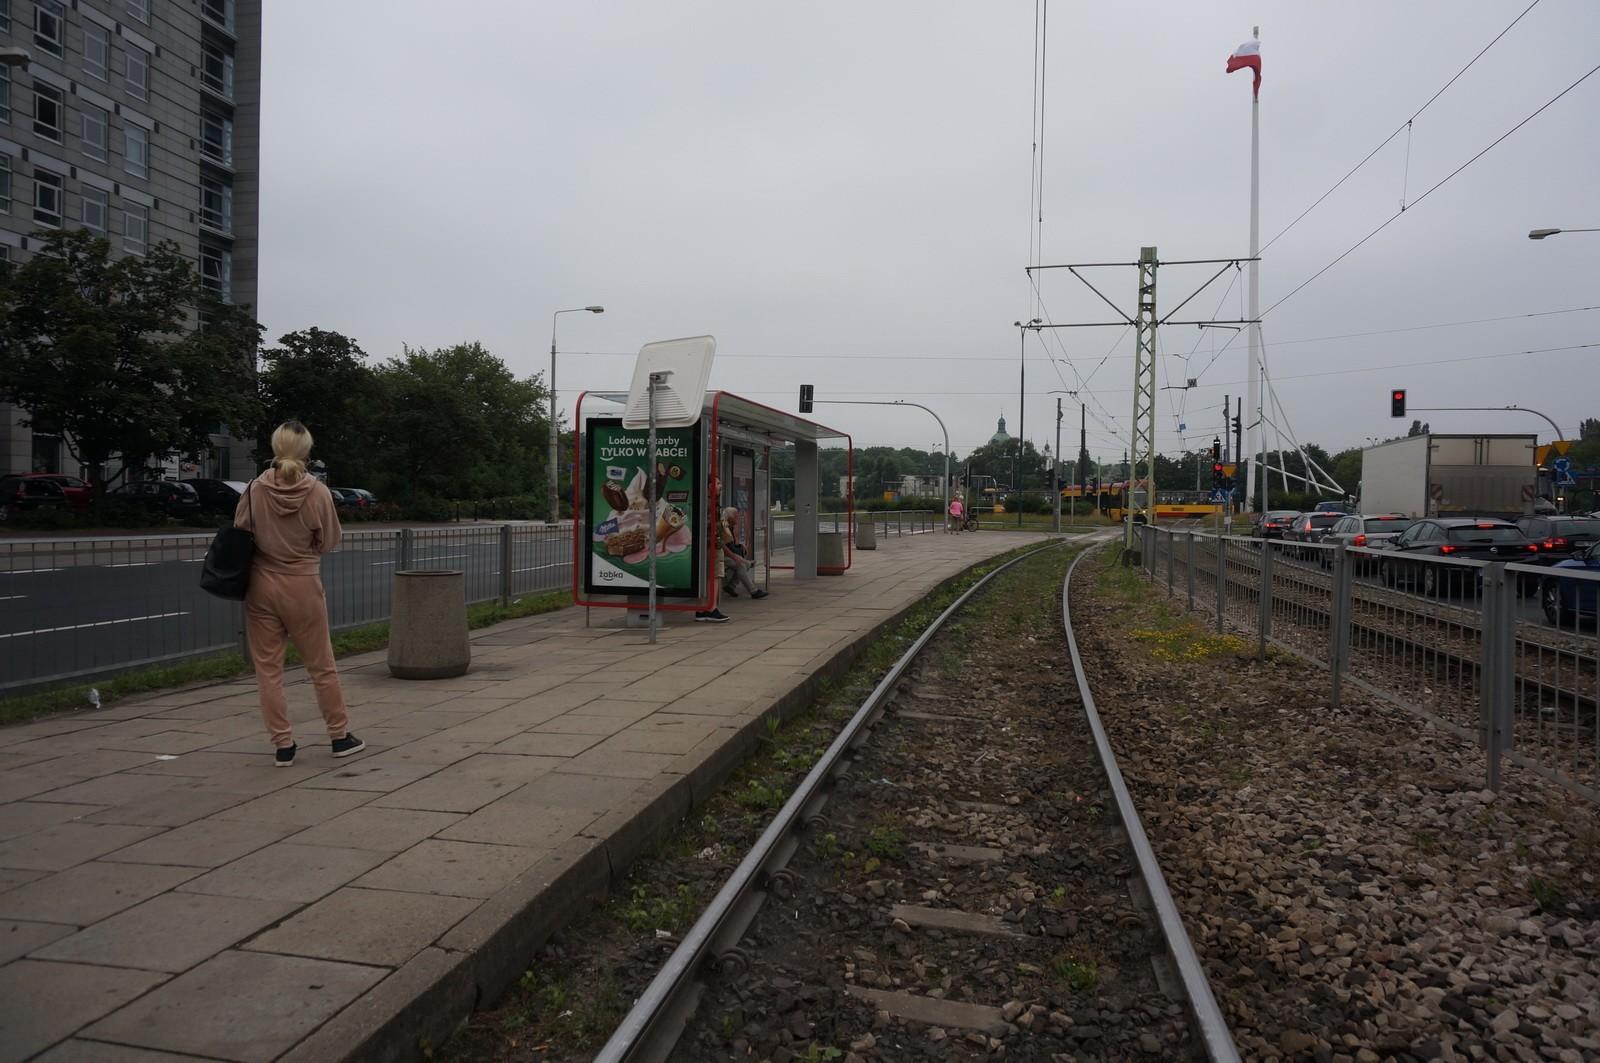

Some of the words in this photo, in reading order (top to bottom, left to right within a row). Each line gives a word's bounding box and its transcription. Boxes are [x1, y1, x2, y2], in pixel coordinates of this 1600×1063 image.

[608, 435, 645, 445] Lodowe
[646, 435, 680, 447] sarby
[601, 447, 634, 457] TYLKO
[636, 447, 647, 457] W
[655, 447, 688, 457] ABCE!
